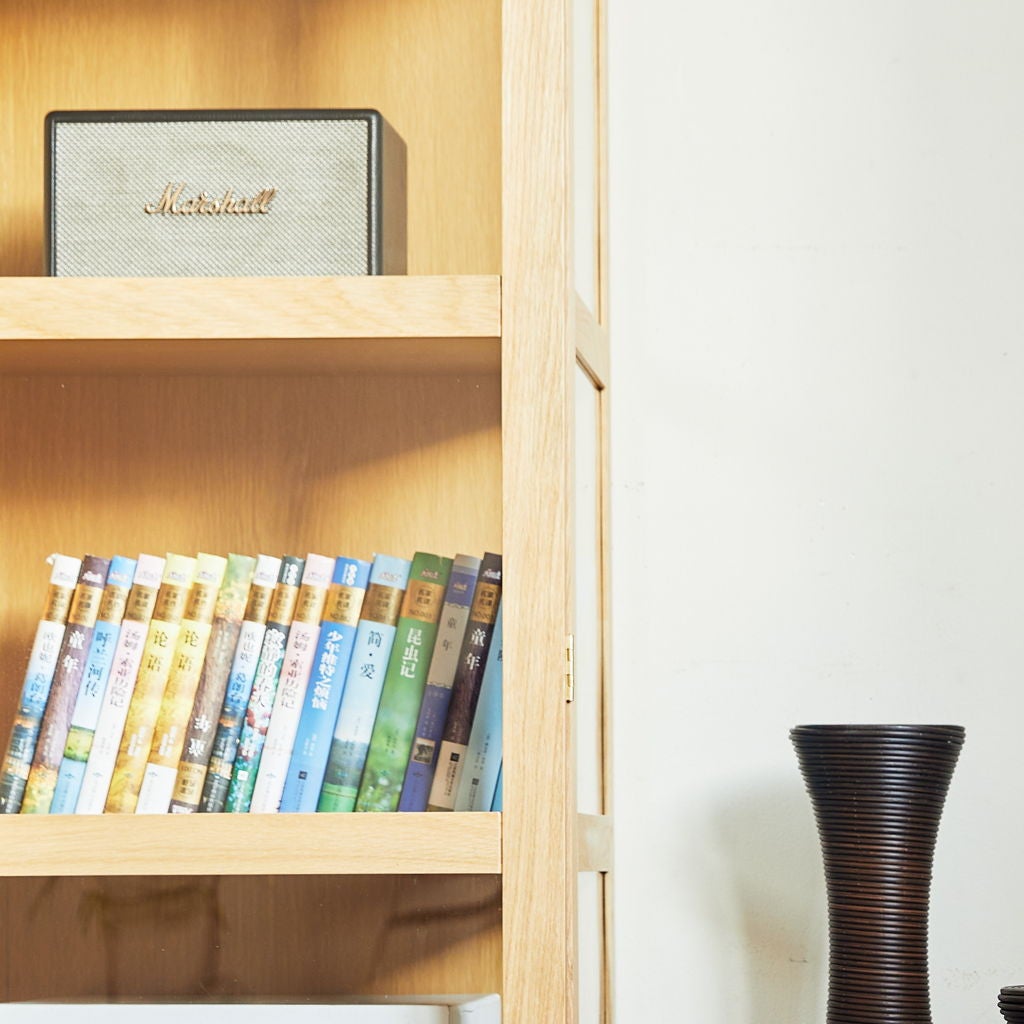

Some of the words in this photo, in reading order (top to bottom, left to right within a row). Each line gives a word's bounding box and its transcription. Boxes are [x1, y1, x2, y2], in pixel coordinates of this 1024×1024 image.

[144, 181, 278, 216] Marshall
[147, 630, 169, 672] 论语
[178, 630, 200, 672] 论语
[360, 630, 384, 680] 简·爱
[400, 627, 422, 679] 昆虫记
[466, 628, 487, 670] 童年
